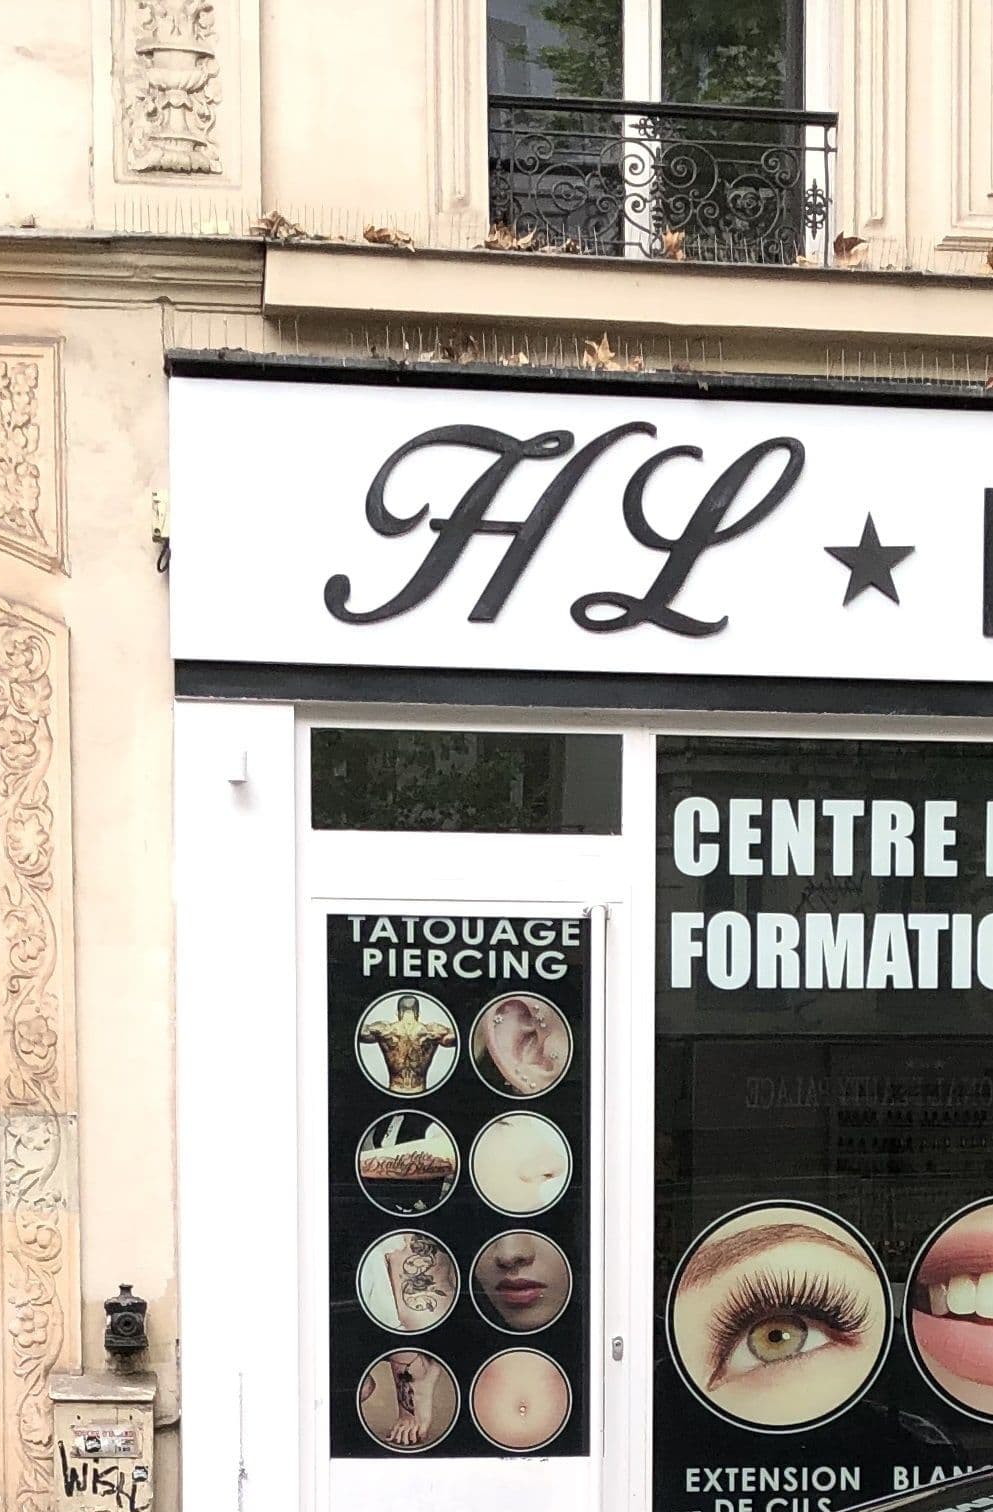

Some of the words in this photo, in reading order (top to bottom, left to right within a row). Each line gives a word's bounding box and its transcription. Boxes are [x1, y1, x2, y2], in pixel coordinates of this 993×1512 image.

[673, 797, 958, 877] CENTRE
[348, 915, 580, 947] TATOUAGE
[362, 948, 568, 980] PIERCING
[685, 1466, 860, 1493] EXTENSION
